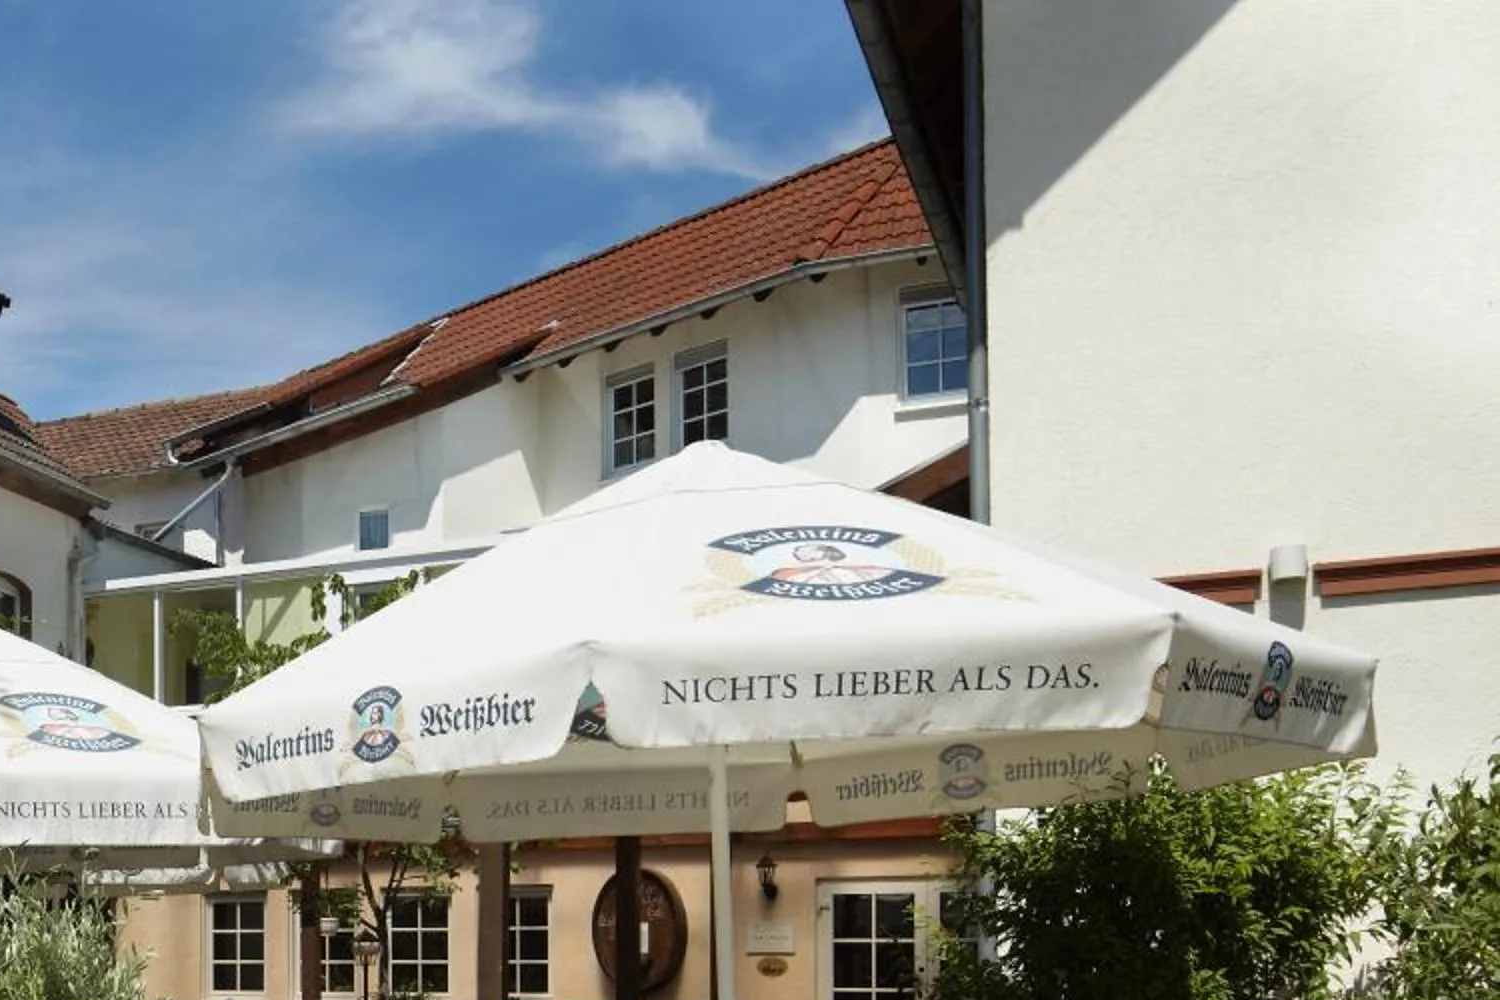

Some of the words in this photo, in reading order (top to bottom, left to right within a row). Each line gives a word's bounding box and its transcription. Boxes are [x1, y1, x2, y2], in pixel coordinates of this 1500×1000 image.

[662, 673, 798, 705] NICHTS
[814, 669, 937, 698] LIEBER
[948, 666, 1012, 692] ALS
[1026, 663, 1100, 690] DAS.
[235, 726, 335, 771] Valentins
[420, 693, 536, 737] Weißbier
[79, 801, 149, 820] LIEBER
[154, 801, 190, 820] ALS
